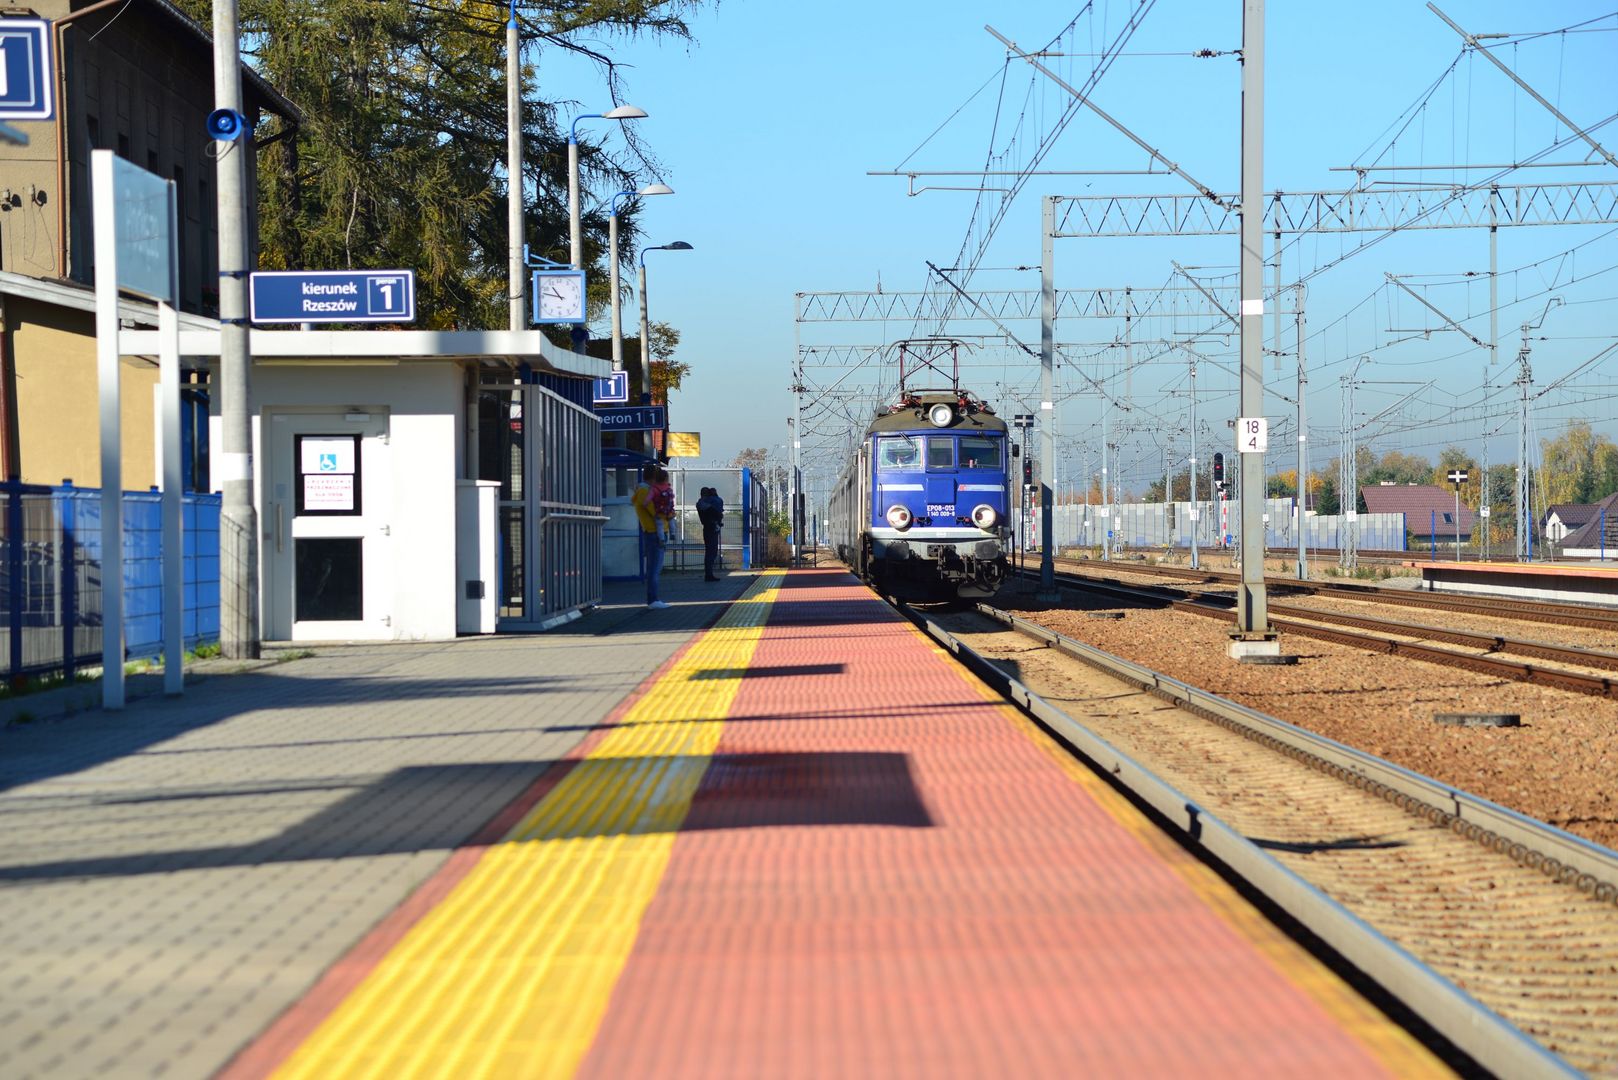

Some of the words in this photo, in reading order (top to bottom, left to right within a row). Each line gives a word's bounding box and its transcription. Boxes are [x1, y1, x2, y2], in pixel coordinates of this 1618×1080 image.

[302, 281, 358, 295] kierunek
[380, 285, 392, 310] 1
[302, 299, 358, 312] Rzeszów
[607, 380, 616, 396] 1
[636, 412, 641, 422] 1
[649, 413, 656, 425] 1
[1246, 420, 1259, 434] 18
[1248, 436, 1256, 450] 4
